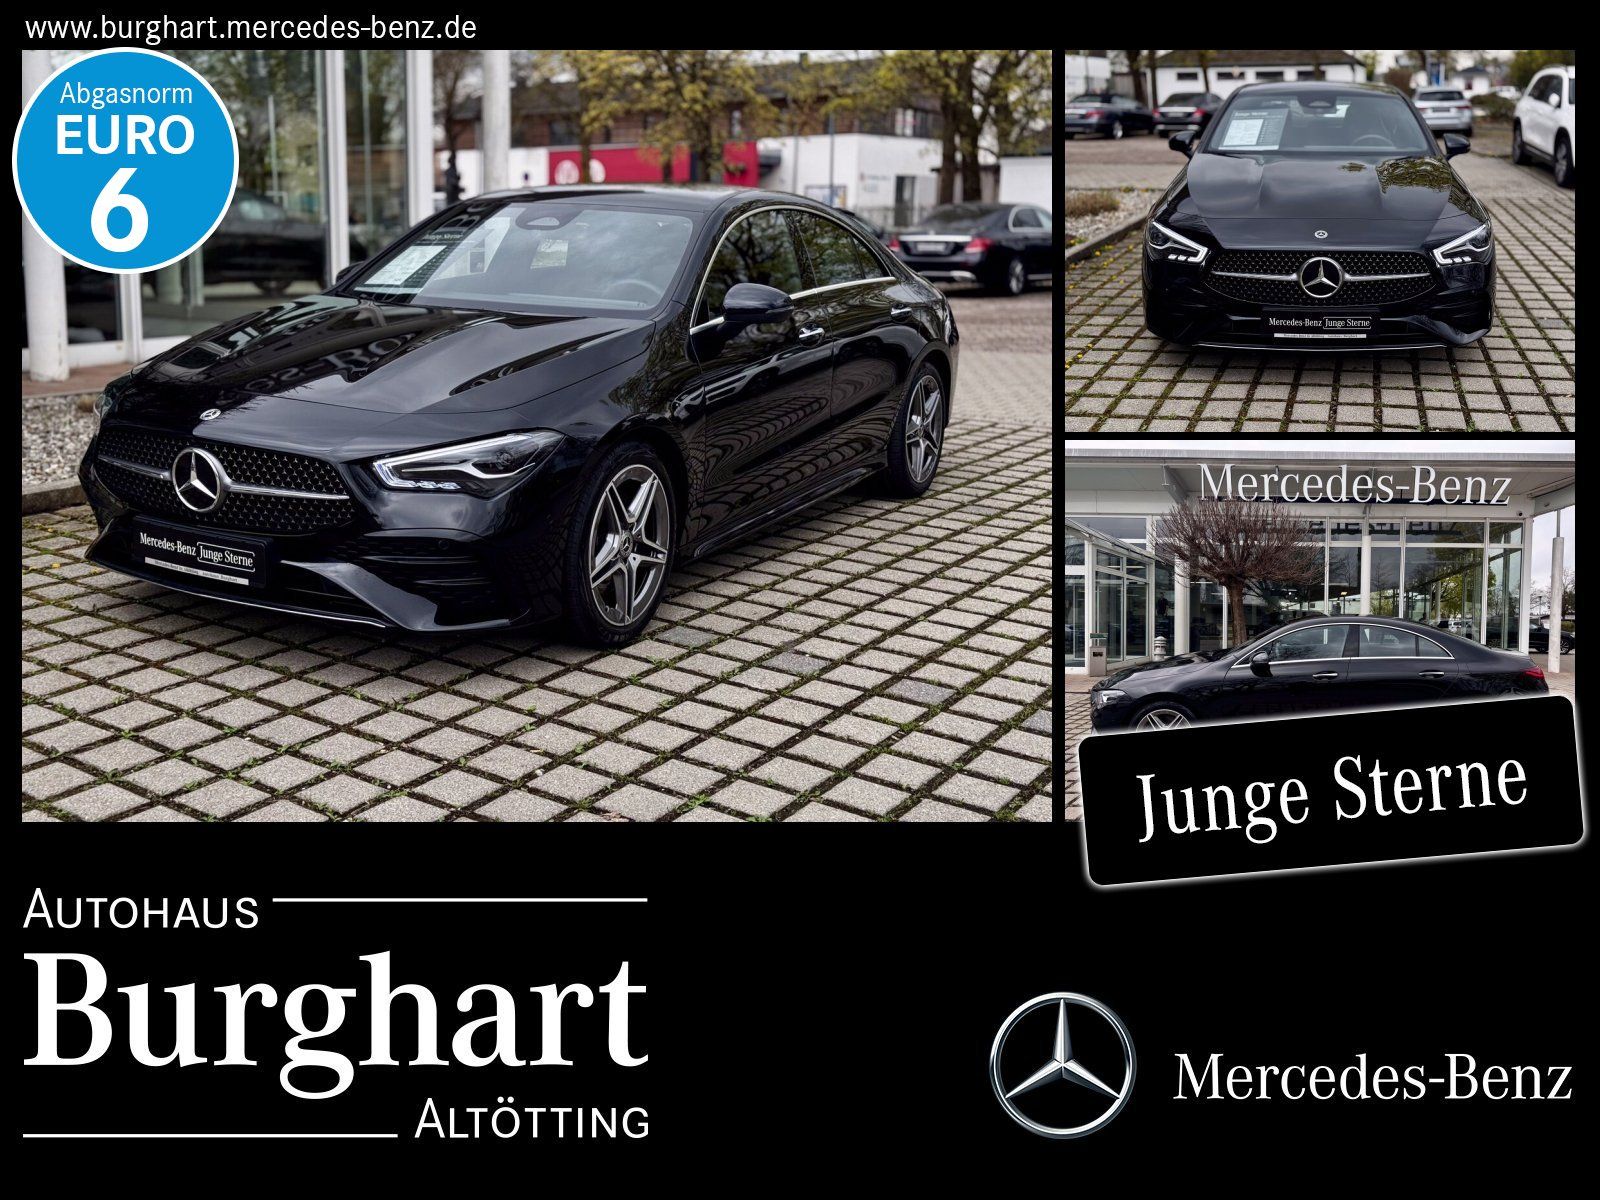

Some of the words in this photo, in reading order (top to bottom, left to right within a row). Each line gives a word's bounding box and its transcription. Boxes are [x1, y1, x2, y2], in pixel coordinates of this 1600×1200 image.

[1269, 318, 1322, 327] Mercedes-Benz
[1325, 319, 1345, 328] Junge
[1346, 319, 1370, 327] Sterne
[1197, 463, 1513, 505] Mercedes-Benz
[140, 532, 196, 556] Mercedes-Benz
[199, 545, 223, 563] Junge
[224, 550, 254, 567] Sterne
